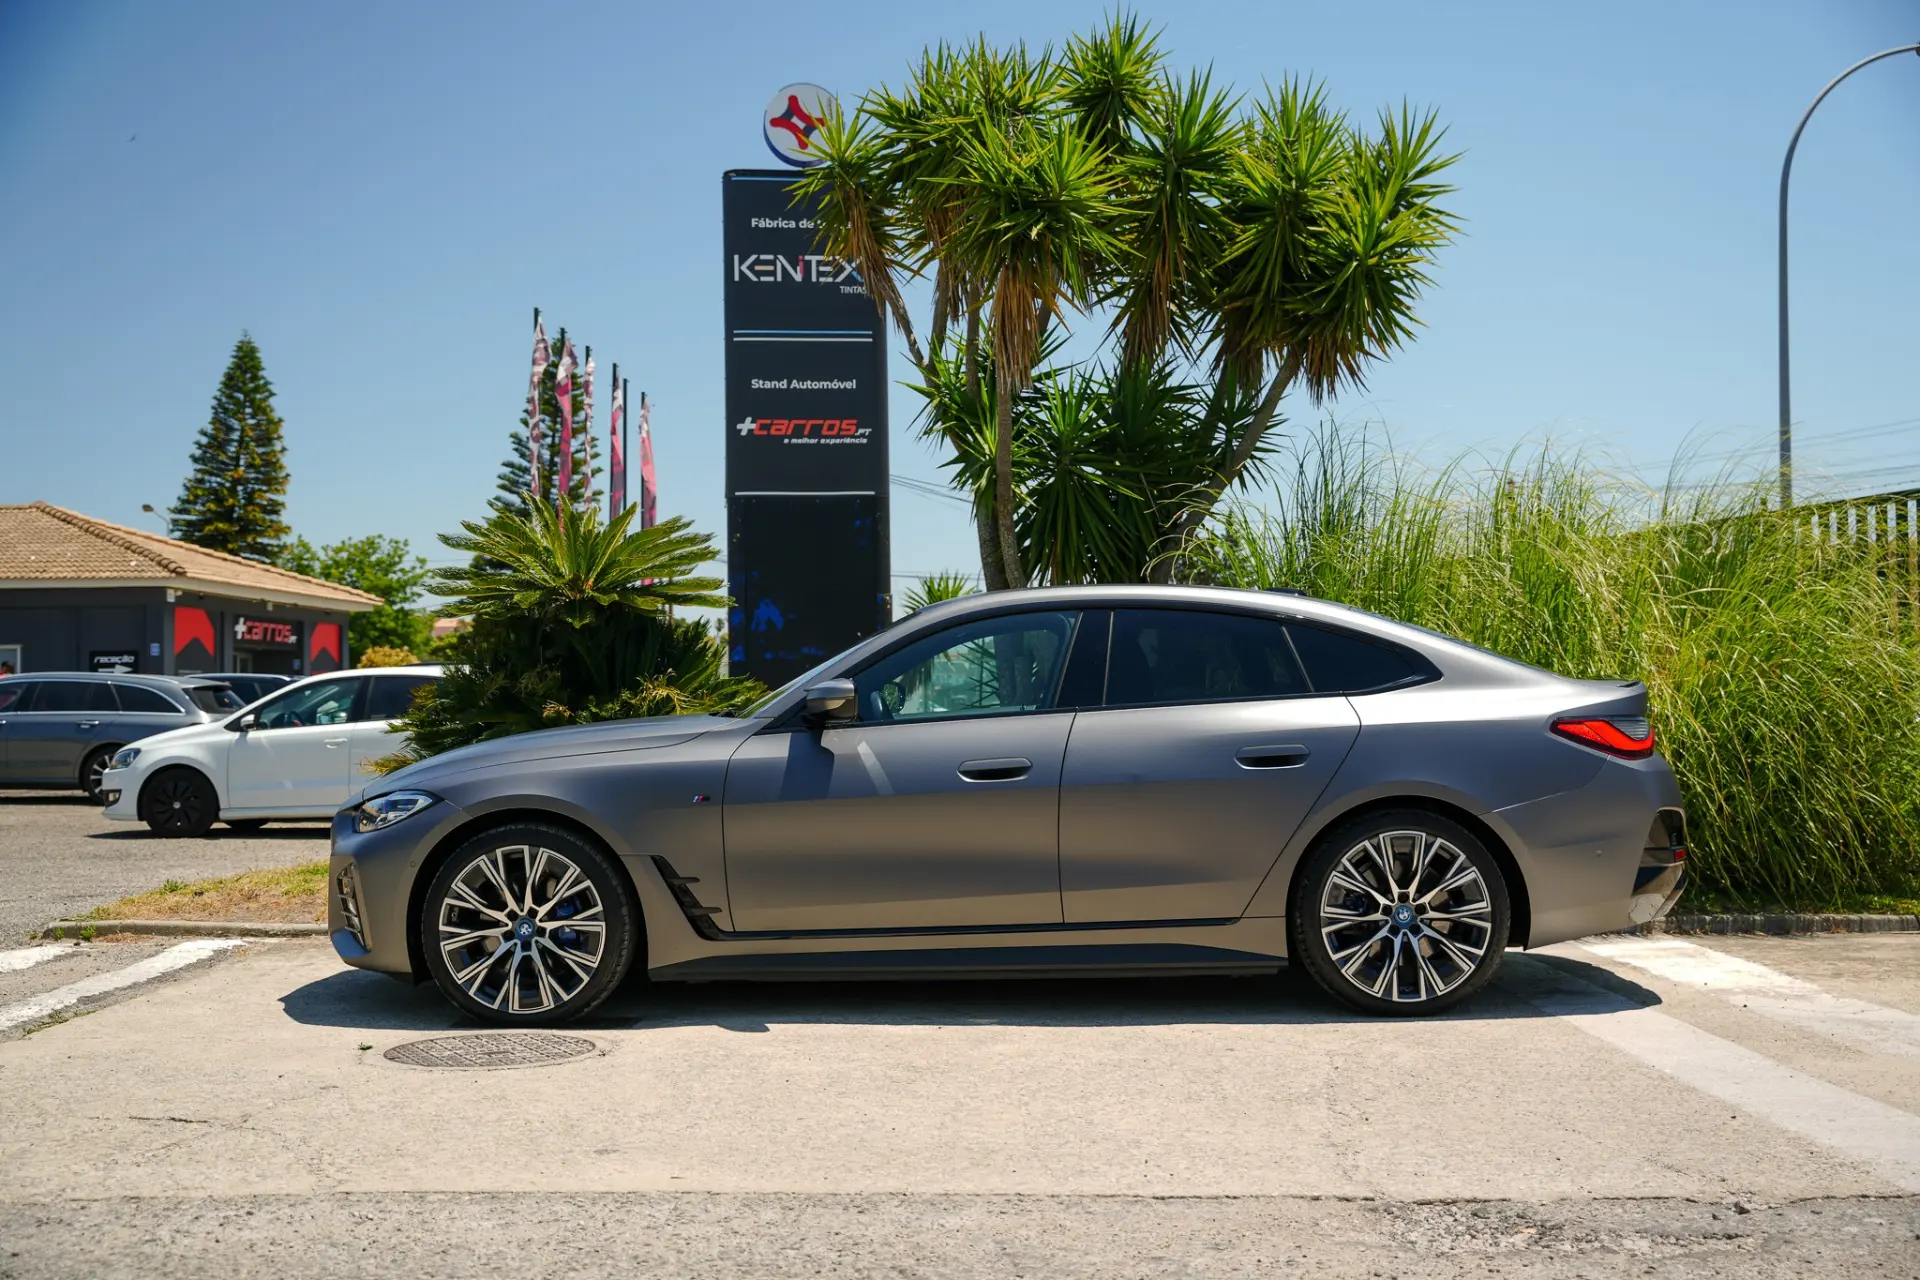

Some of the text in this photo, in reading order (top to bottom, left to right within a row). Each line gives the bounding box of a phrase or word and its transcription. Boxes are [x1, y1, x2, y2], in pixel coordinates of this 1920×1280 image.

[751, 217, 796, 229] Fábrica
[799, 218, 815, 229] de
[751, 378, 857, 389] Stand Automóvel
[820, 437, 868, 445] experiência
